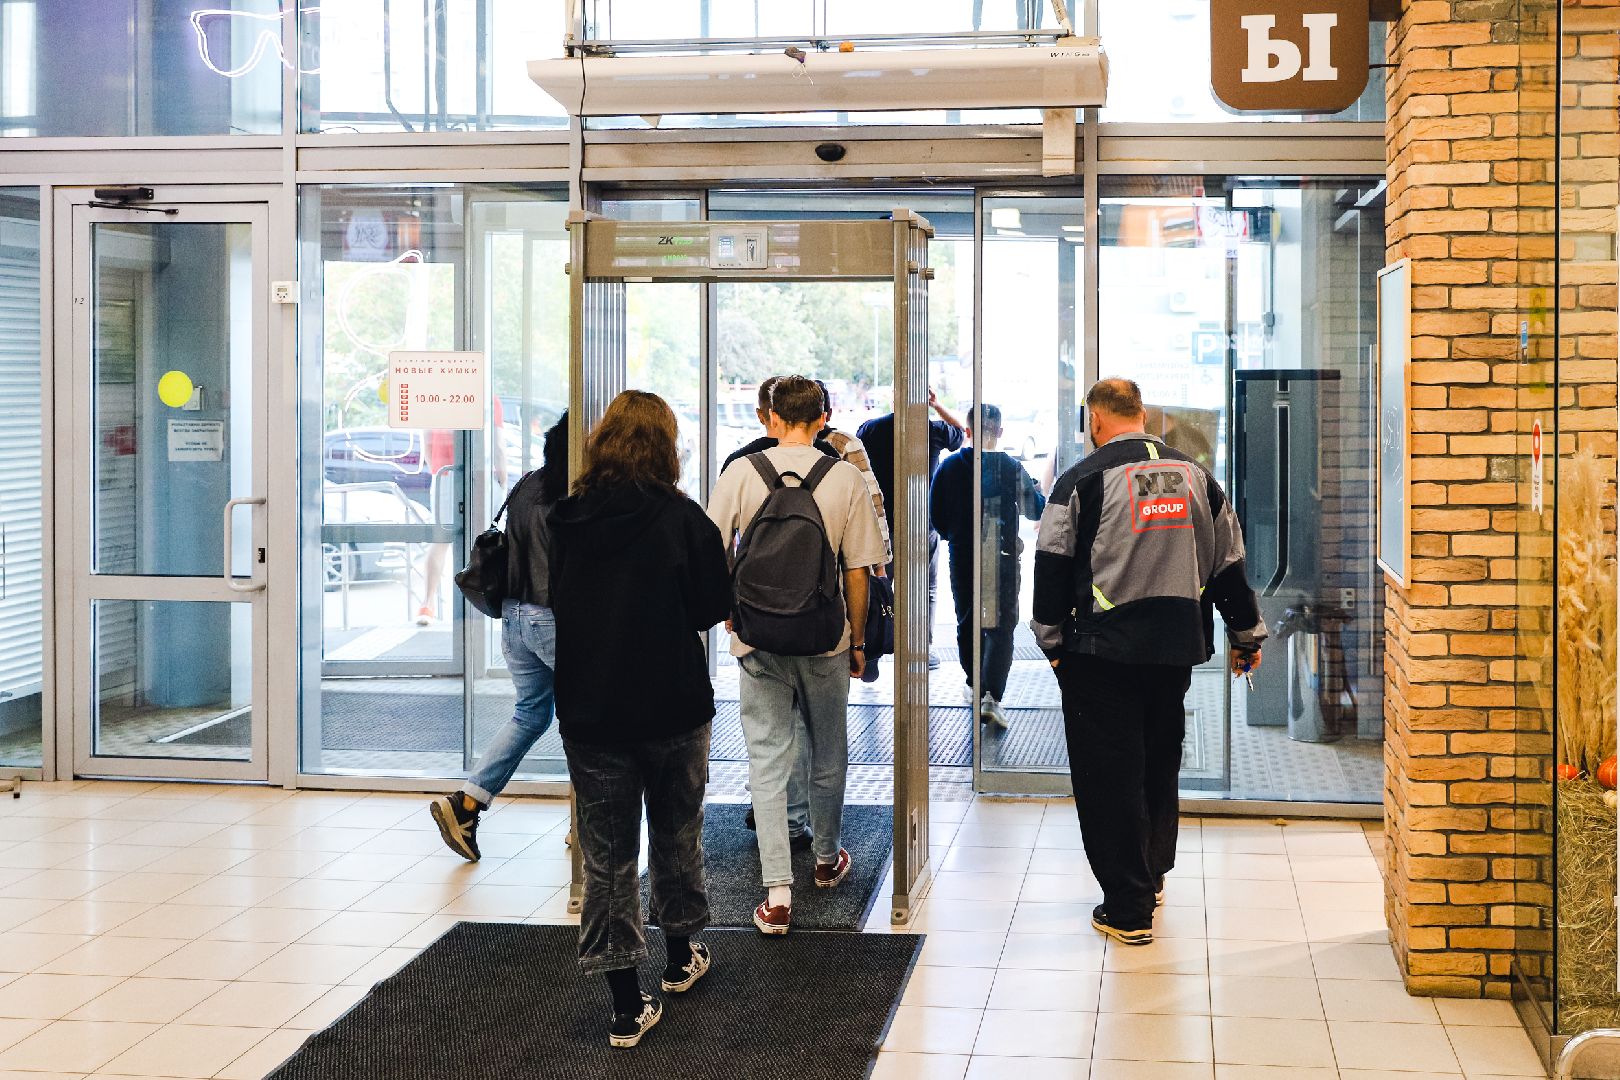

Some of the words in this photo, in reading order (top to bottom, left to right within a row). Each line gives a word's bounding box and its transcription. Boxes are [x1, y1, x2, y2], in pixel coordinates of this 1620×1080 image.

[1240, 13, 1338, 83] Ы
[1135, 471, 1184, 497] NP
[1142, 503, 1184, 516] GROUP
